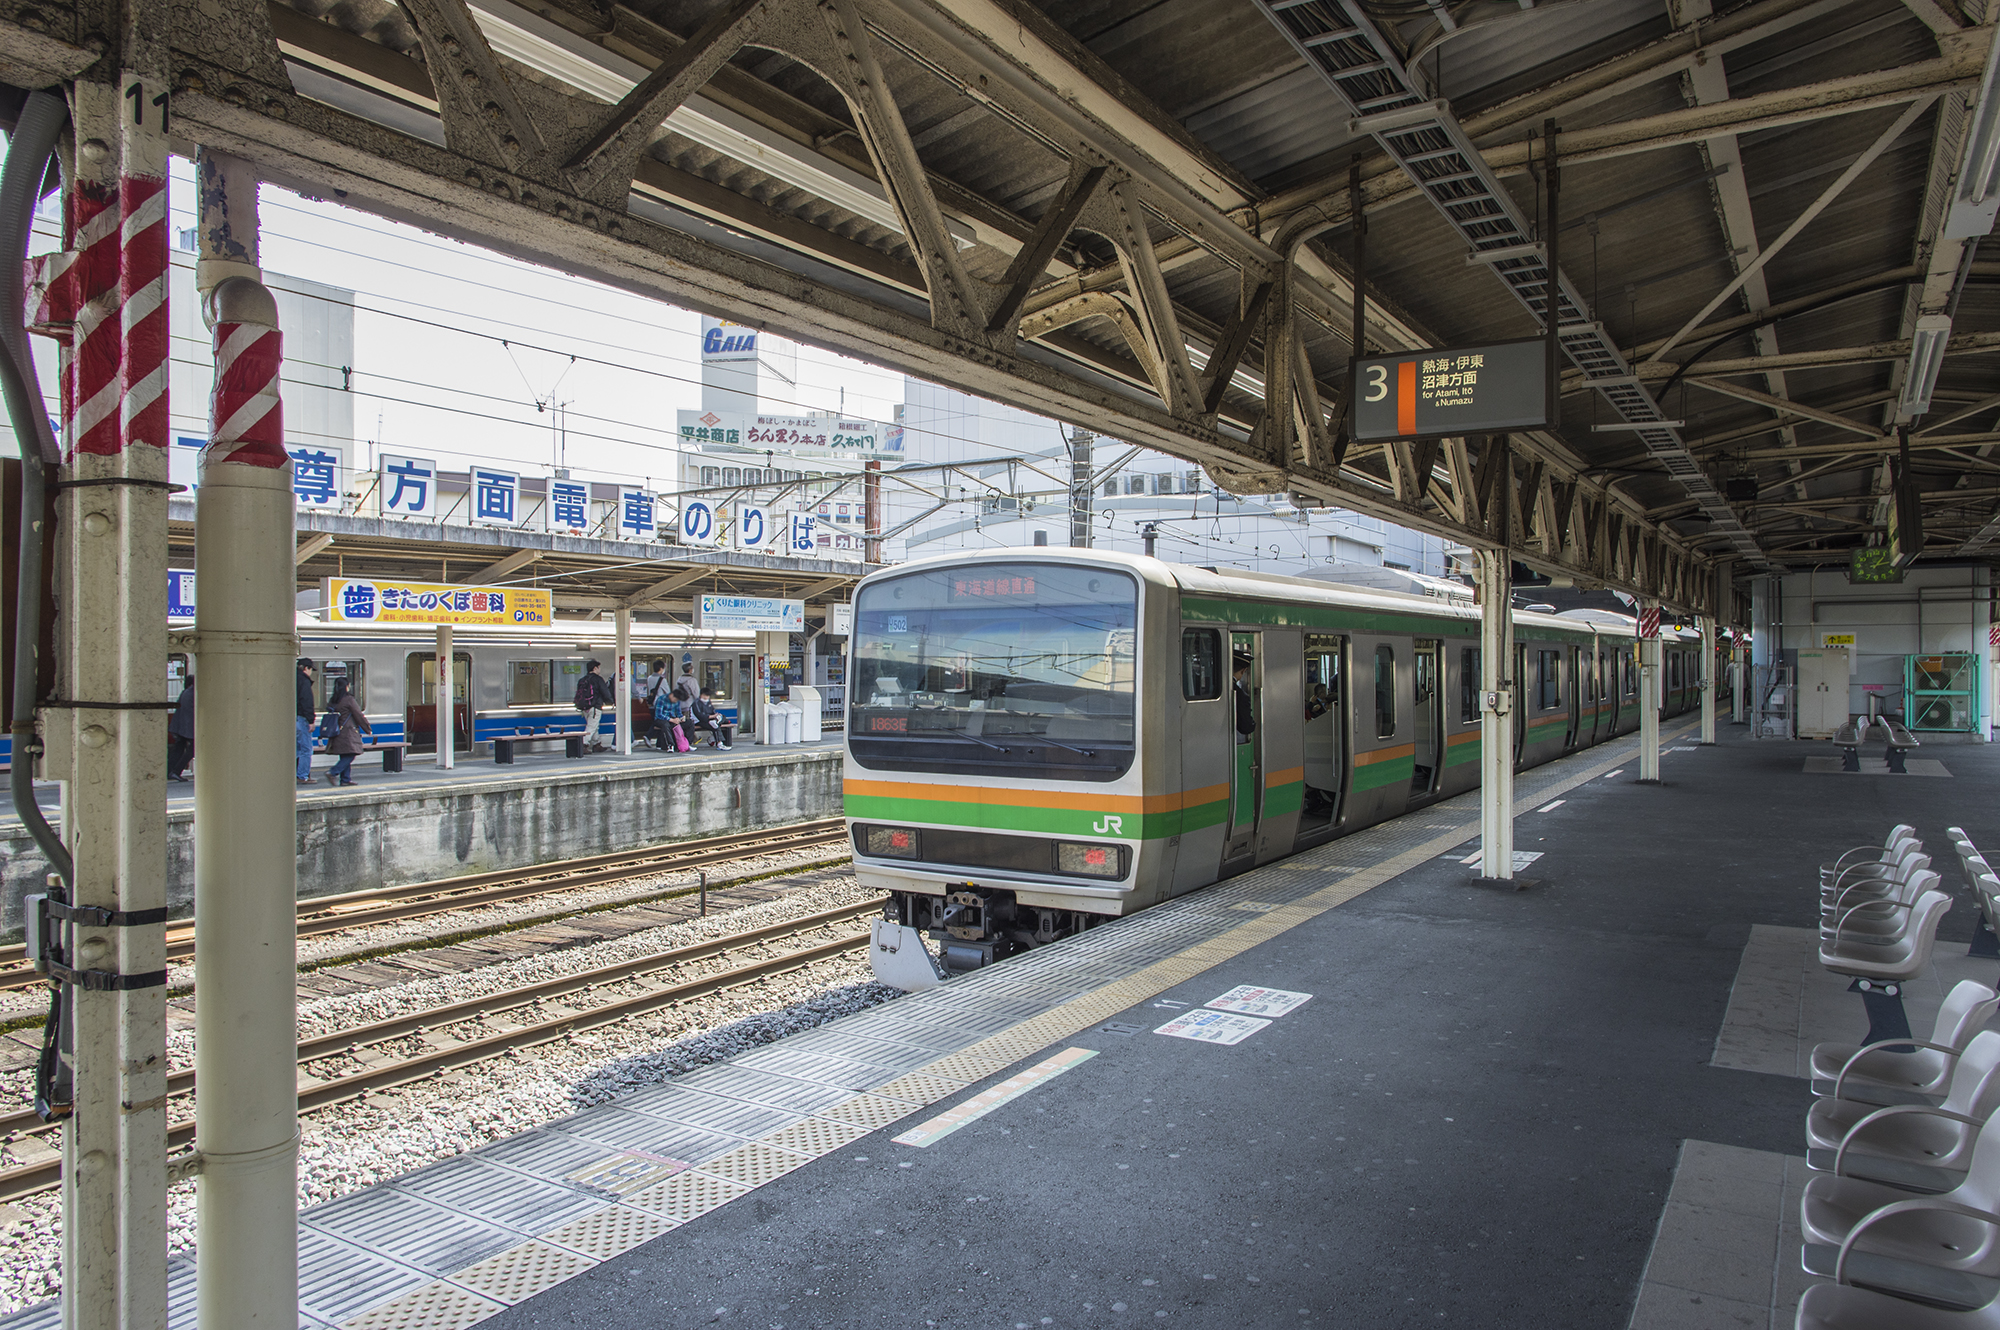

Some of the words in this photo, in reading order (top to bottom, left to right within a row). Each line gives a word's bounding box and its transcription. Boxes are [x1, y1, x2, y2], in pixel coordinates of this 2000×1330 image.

[125, 81, 170, 134] 11
[703, 327, 756, 354] GAIA
[1422, 354, 1484, 374] 熱海・伊東
[1364, 364, 1388, 403] 3
[1422, 370, 1478, 390] 沼津方面
[1422, 390, 1433, 399] for
[1435, 387, 1460, 398] Atami,
[1440, 397, 1473, 407] Numazu
[757, 416, 817, 428] 梅ぼし・かまぼこ
[838, 422, 867, 431] 箱根細工
[680, 425, 740, 444] 平井商店
[178, 437, 816, 550] 尊方面電車のりば
[954, 576, 1036, 597] 東海道線直通
[343, 585, 376, 619] 歯
[381, 588, 505, 613] きたのくぼ歯科
[716, 598, 773, 609] くりた眼科クリニック
[169, 607, 183, 615] AX
[525, 611, 543, 622] 10台
[870, 716, 908, 732] 1863E
[1093, 814, 1123, 835] JR
